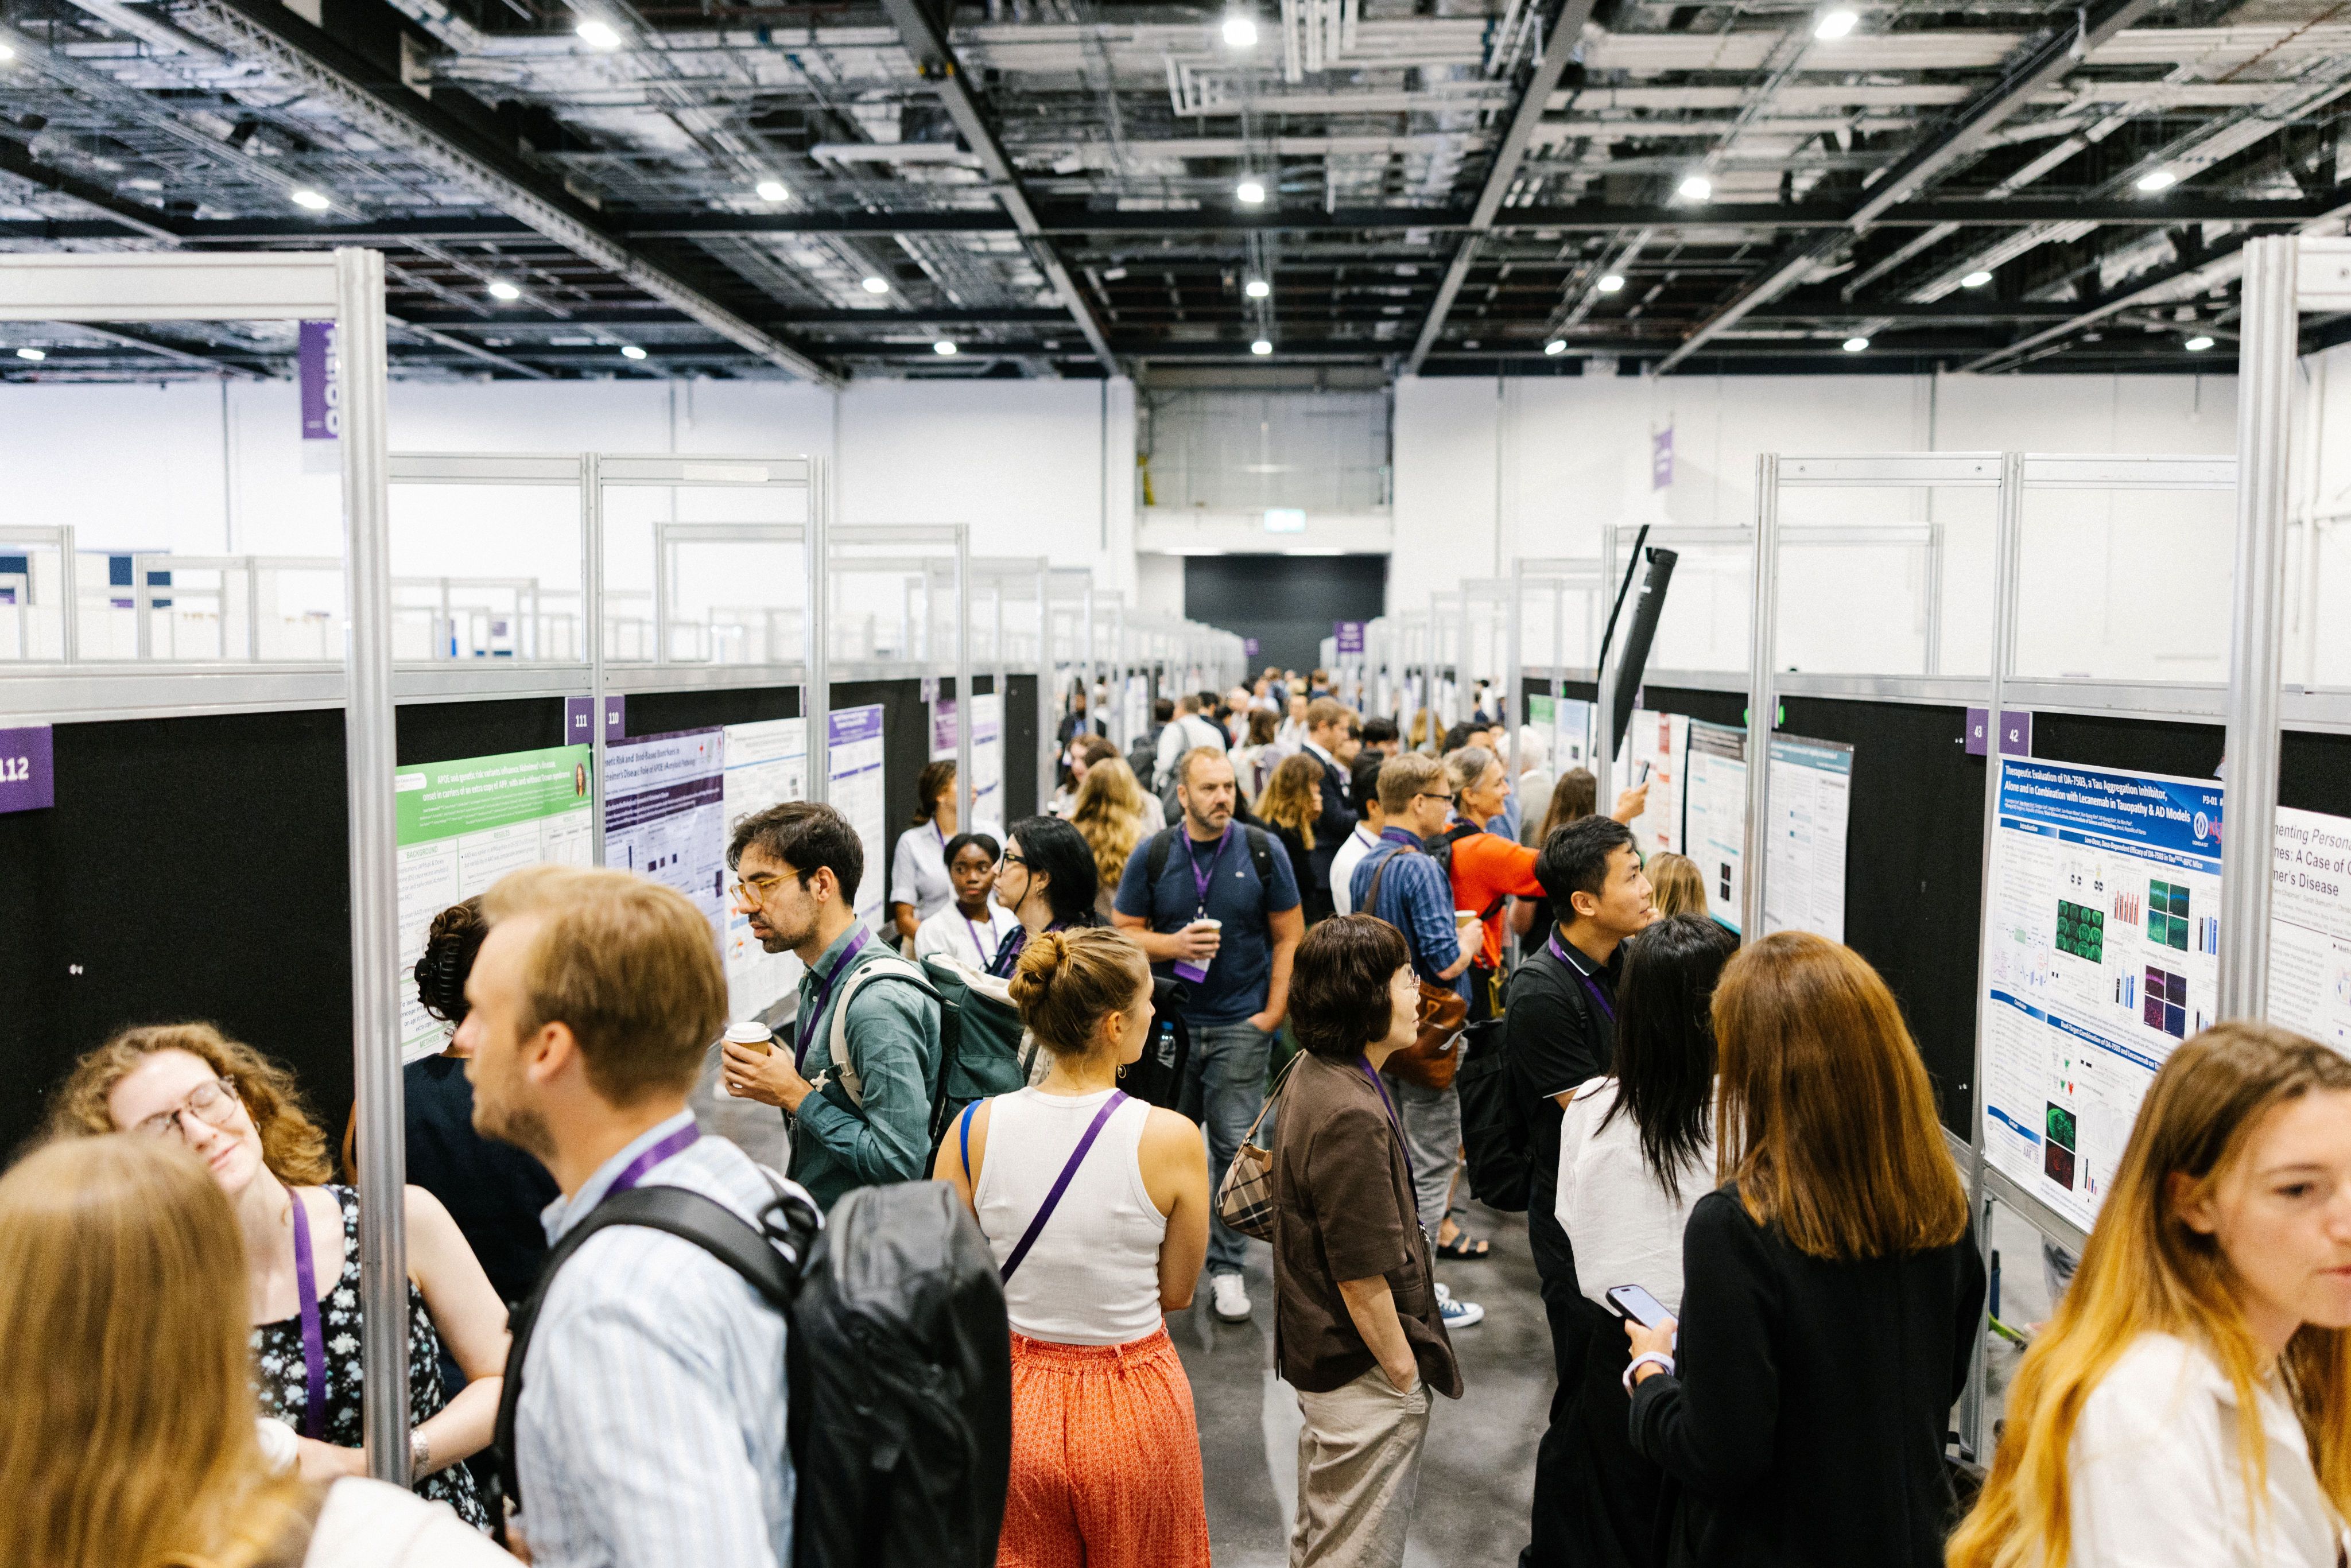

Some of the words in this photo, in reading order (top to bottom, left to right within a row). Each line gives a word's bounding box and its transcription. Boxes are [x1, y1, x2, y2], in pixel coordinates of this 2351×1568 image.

[576, 714, 587, 727] 111
[608, 712, 619, 725] 110
[1974, 725, 1983, 738] 43
[2009, 729, 2019, 742] 42
[437, 774, 450, 785] APOE
[451, 773, 459, 782] and
[459, 771, 475, 783] genetic
[475, 770, 484, 779] risk
[484, 767, 501, 777] variants
[501, 766, 519, 774] influence
[519, 762, 541, 772] Alzheimer's
[541, 760, 556, 769] disease
[422, 791, 437, 801] onset
[437, 790, 442, 799] in
[443, 788, 460, 798] carriers
[460, 786, 465, 795] of
[472, 785, 483, 793] extra
[483, 783, 494, 793] copy
[494, 781, 499, 789] of
[509, 778, 518, 787] with
[518, 777, 526, 785] and
[526, 774, 541, 784] without
[553, 771, 570, 781] syndrome
[2005, 765, 2032, 779] Therapeutic
[2032, 769, 2057, 783] Evaluation
[2058, 773, 2063, 783] of
[2063, 774, 2088, 789] DA-7503,
[2088, 780, 2092, 788] a
[2092, 778, 2102, 790] Tau
[2104, 780, 2138, 795] Aggregation
[2138, 785, 2168, 802] Inhibitor,
[2004, 781, 2019, 792] Alone
[2019, 784, 2028, 794] and
[2029, 784, 2034, 794] in
[2035, 785, 2066, 800] Combination
[2066, 791, 2078, 802] with
[2079, 793, 2109, 808] Lecanemab
[2110, 797, 2116, 809] in
[2116, 799, 2148, 817] Tauopathy
[2148, 804, 2155, 816] &
[2155, 805, 2165, 818] AD
[2166, 808, 2191, 822] Models
[2202, 795, 2218, 806] P3-01
[2019, 822, 2038, 832] Introduction
[406, 846, 438, 859] BACKGROUND
[2085, 836, 2101, 847] Low-Dose,
[2101, 840, 2130, 852] Dose-Dependent
[2130, 846, 2144, 857] Efficacy
[2164, 853, 2168, 861] in
[2192, 860, 2203, 869] Mice
[2295, 849, 2303, 864] A
[2306, 851, 2330, 870] Case
[2334, 859, 2345, 874] of
[2299, 873, 2338, 896] Disease
[420, 1034, 440, 1048] METHODS
[2061, 1020, 2079, 1035] Dual-Target
[2079, 1029, 2101, 1043] Combination
[2105, 1040, 2120, 1053] DA-7503
[2128, 1050, 2149, 1066] Lecanemab
